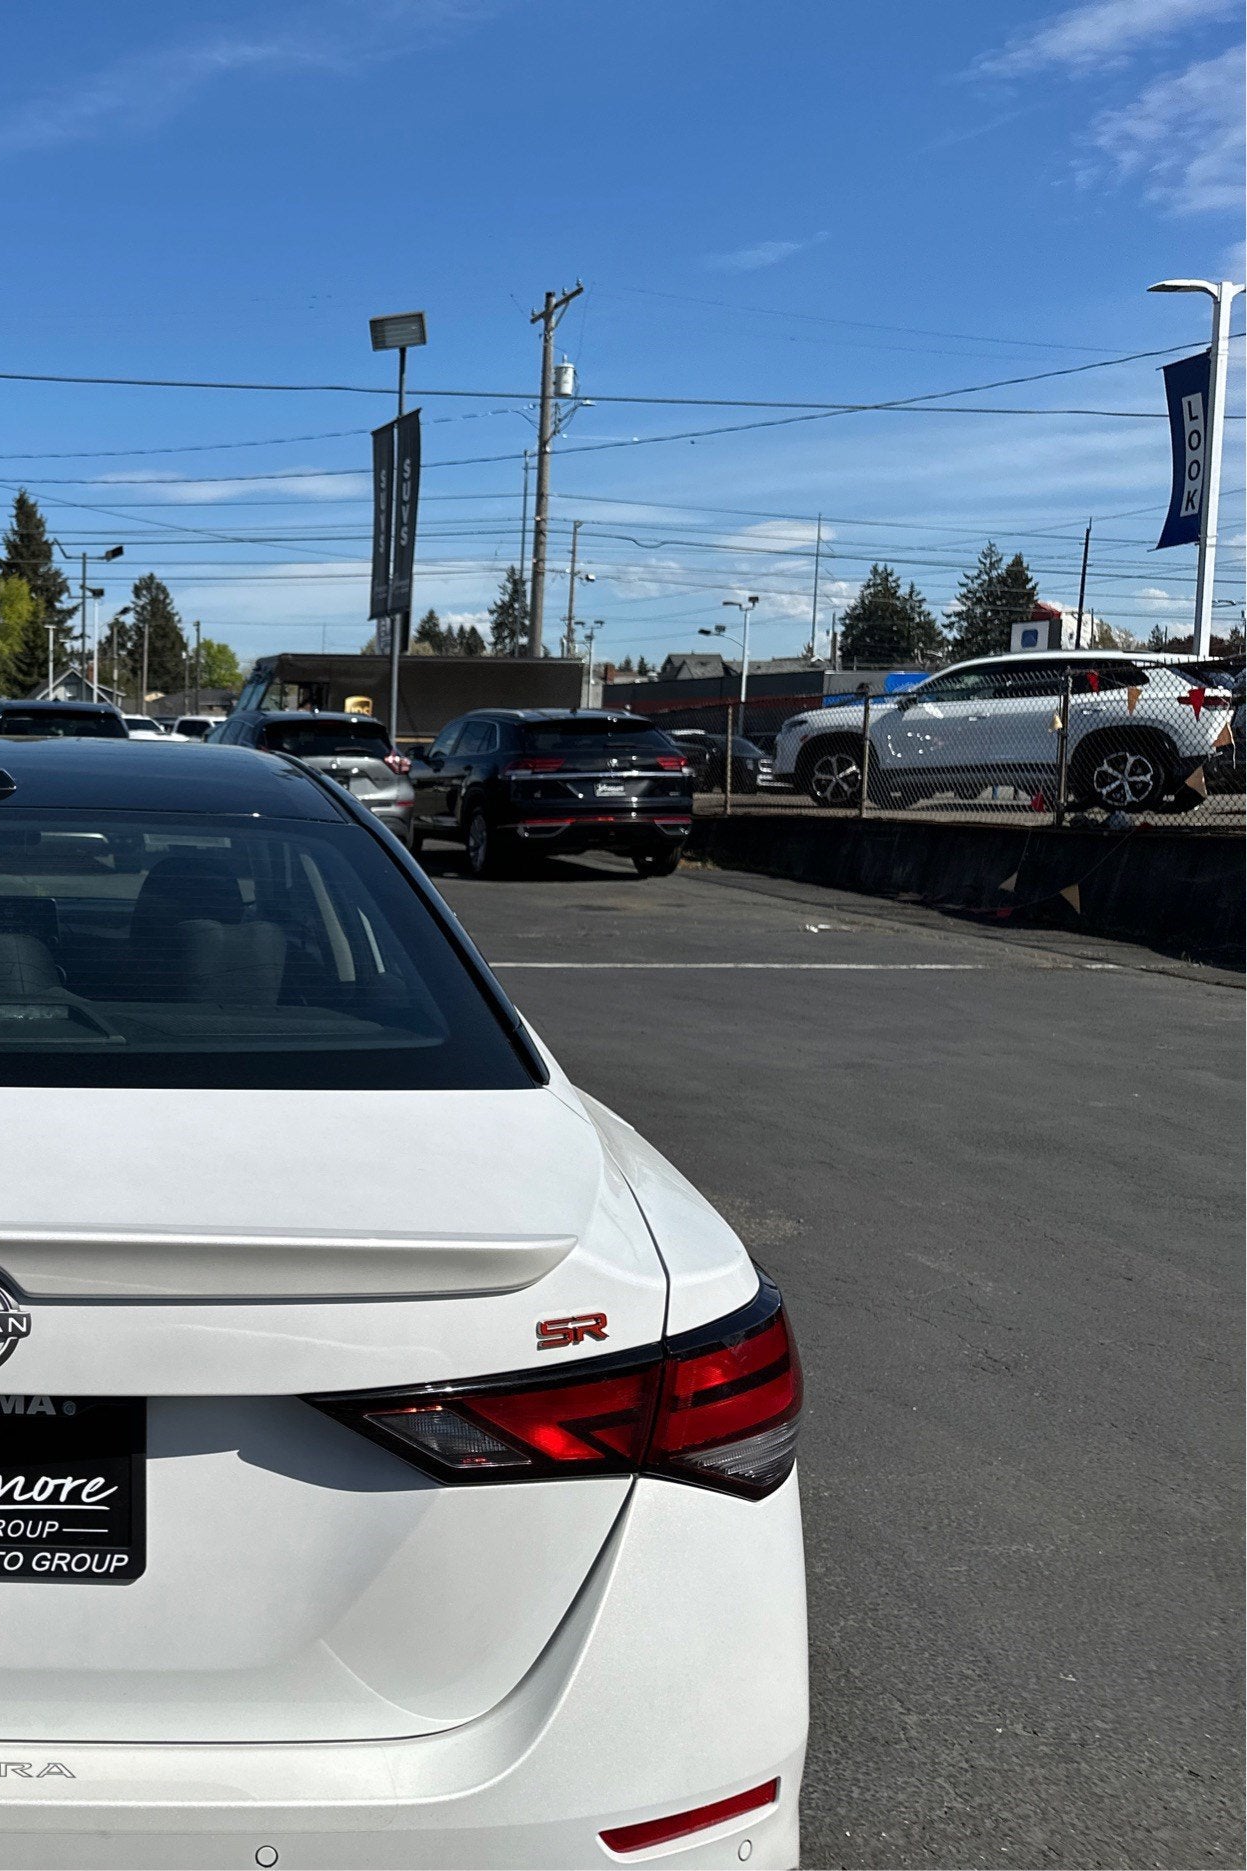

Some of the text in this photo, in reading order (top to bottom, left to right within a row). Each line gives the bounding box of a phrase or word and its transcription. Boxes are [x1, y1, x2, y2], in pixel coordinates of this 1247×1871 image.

[1185, 401, 1201, 512] LOOK
[400, 458, 411, 547] SUVS
[536, 1312, 609, 1351] SR
[31, 1551, 129, 1574] GROUP
